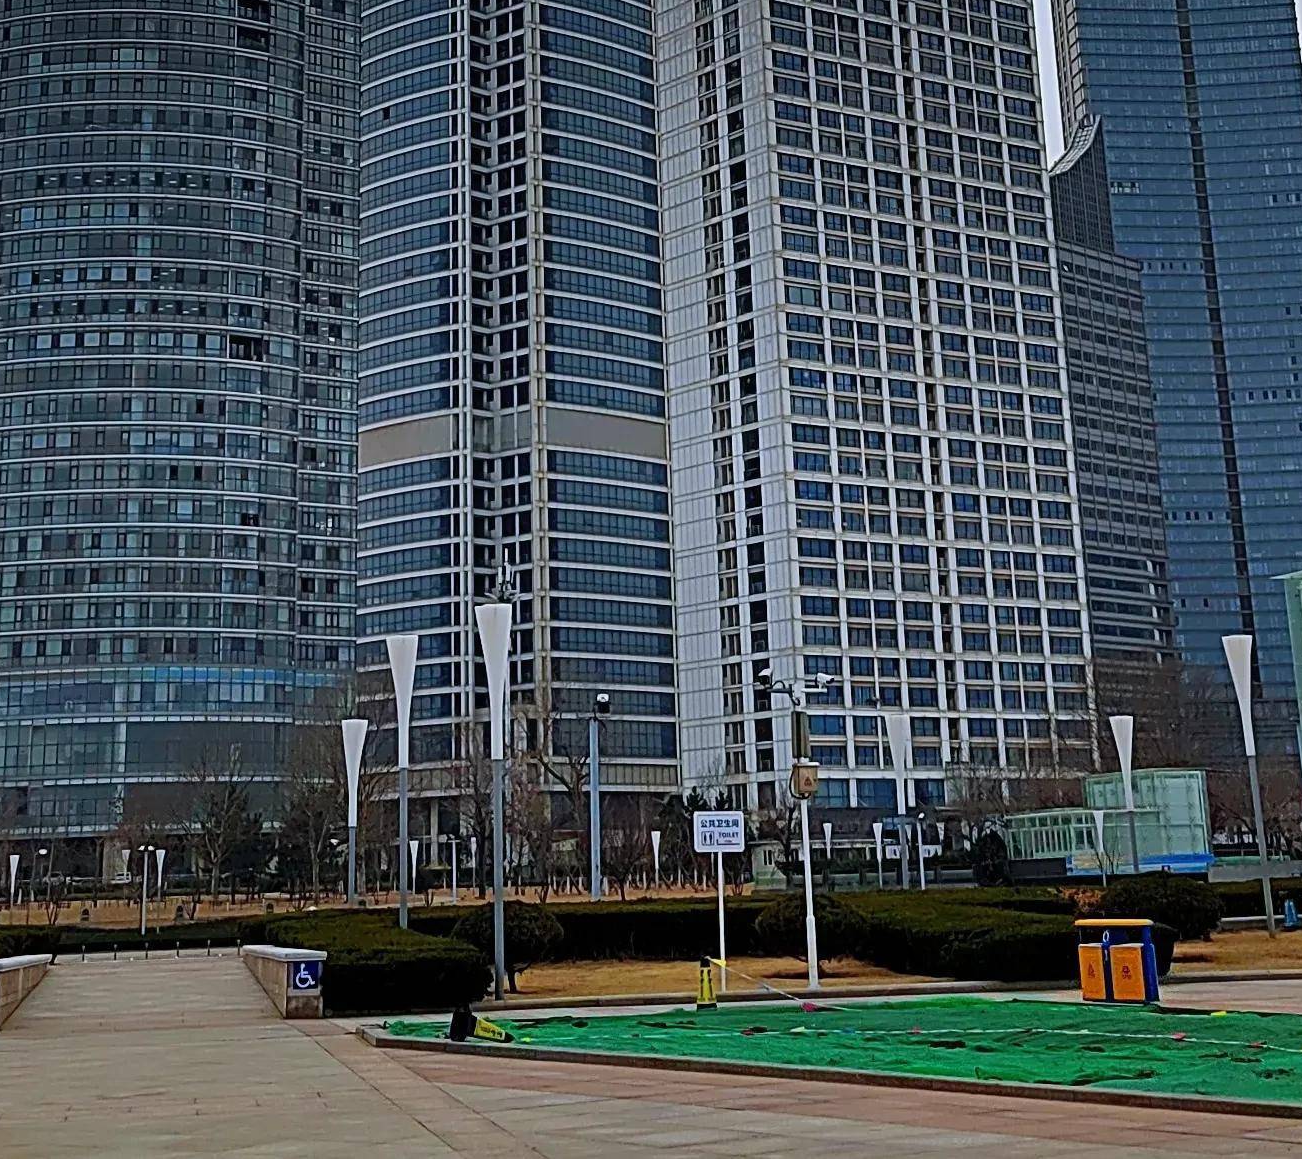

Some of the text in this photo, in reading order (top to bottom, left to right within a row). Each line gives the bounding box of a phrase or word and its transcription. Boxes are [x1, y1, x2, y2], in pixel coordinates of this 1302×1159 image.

[701, 819, 739, 828] 公共卫生间
